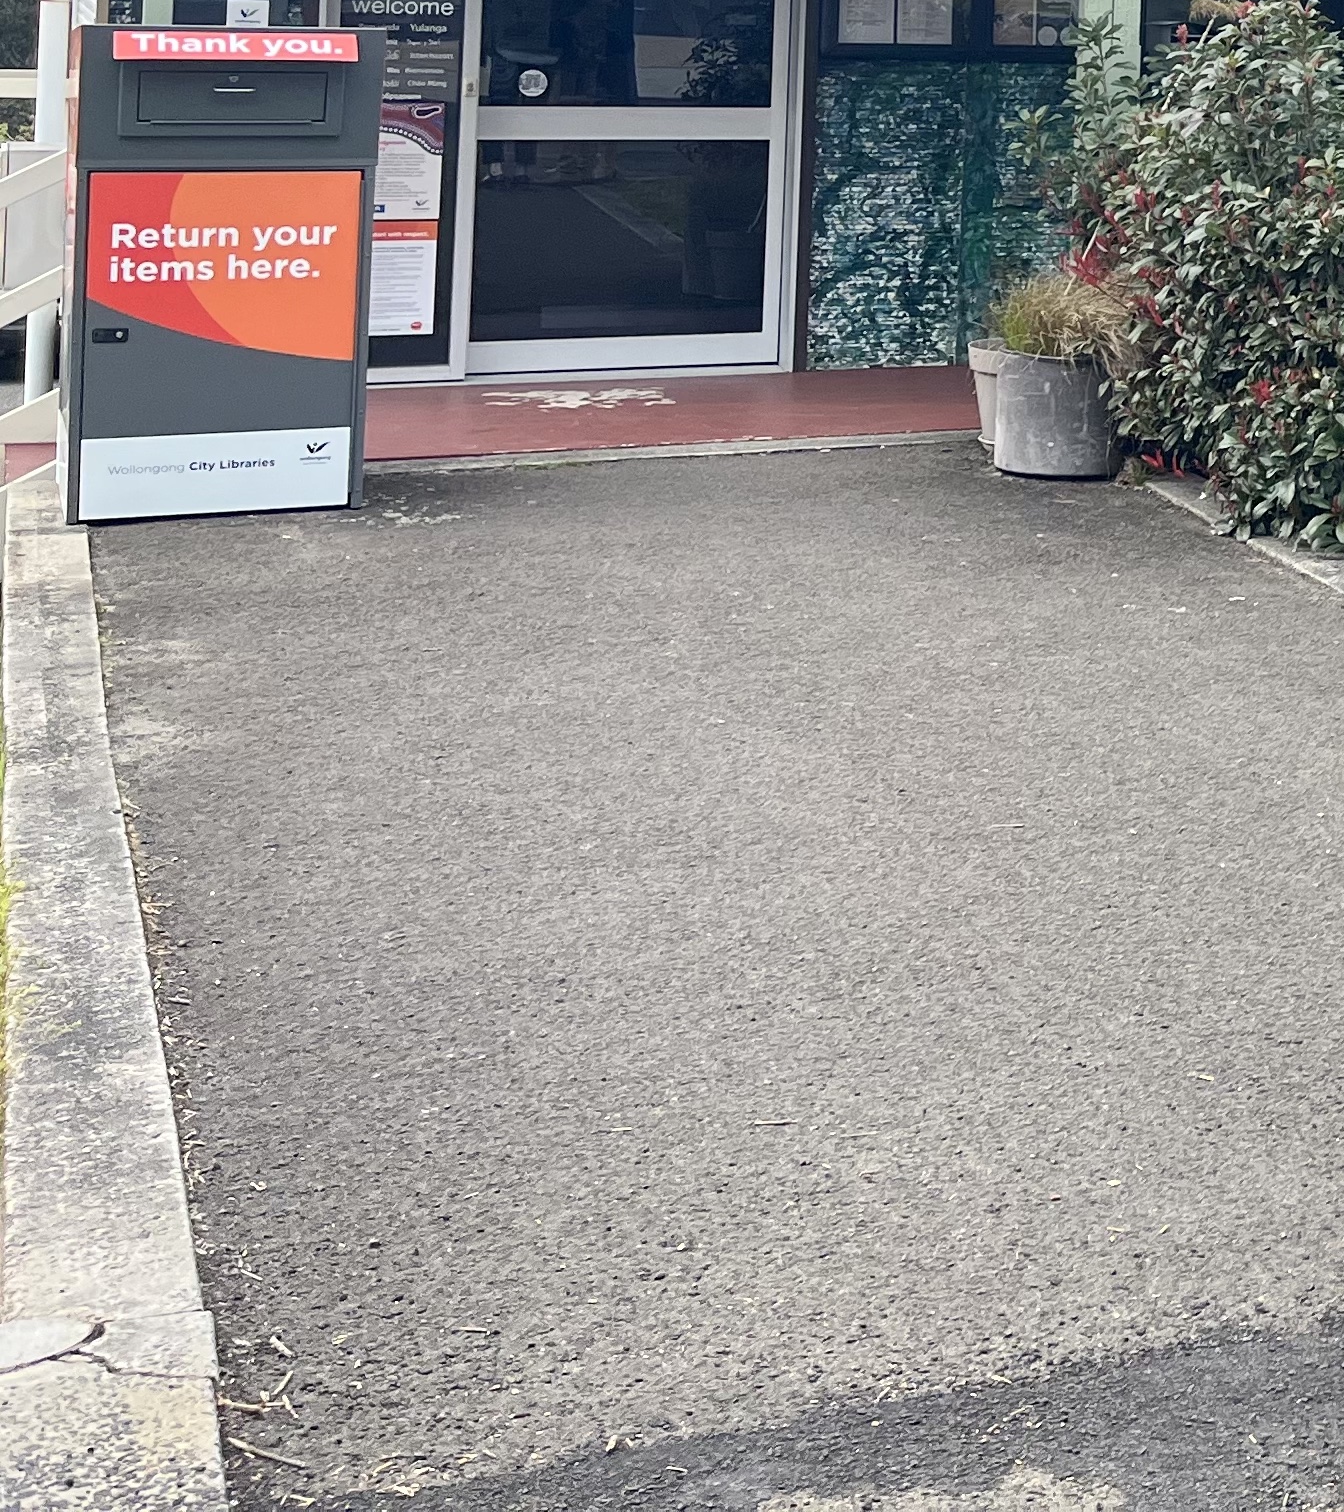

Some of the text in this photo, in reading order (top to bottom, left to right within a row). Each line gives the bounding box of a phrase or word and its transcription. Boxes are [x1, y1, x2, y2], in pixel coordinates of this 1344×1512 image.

[410, 24, 447, 33] Yulanga
[132, 33, 344, 56] Thank you.
[110, 223, 338, 250] Return your
[109, 253, 320, 282] items here.
[108, 458, 275, 475] Wollongong City Libraries
